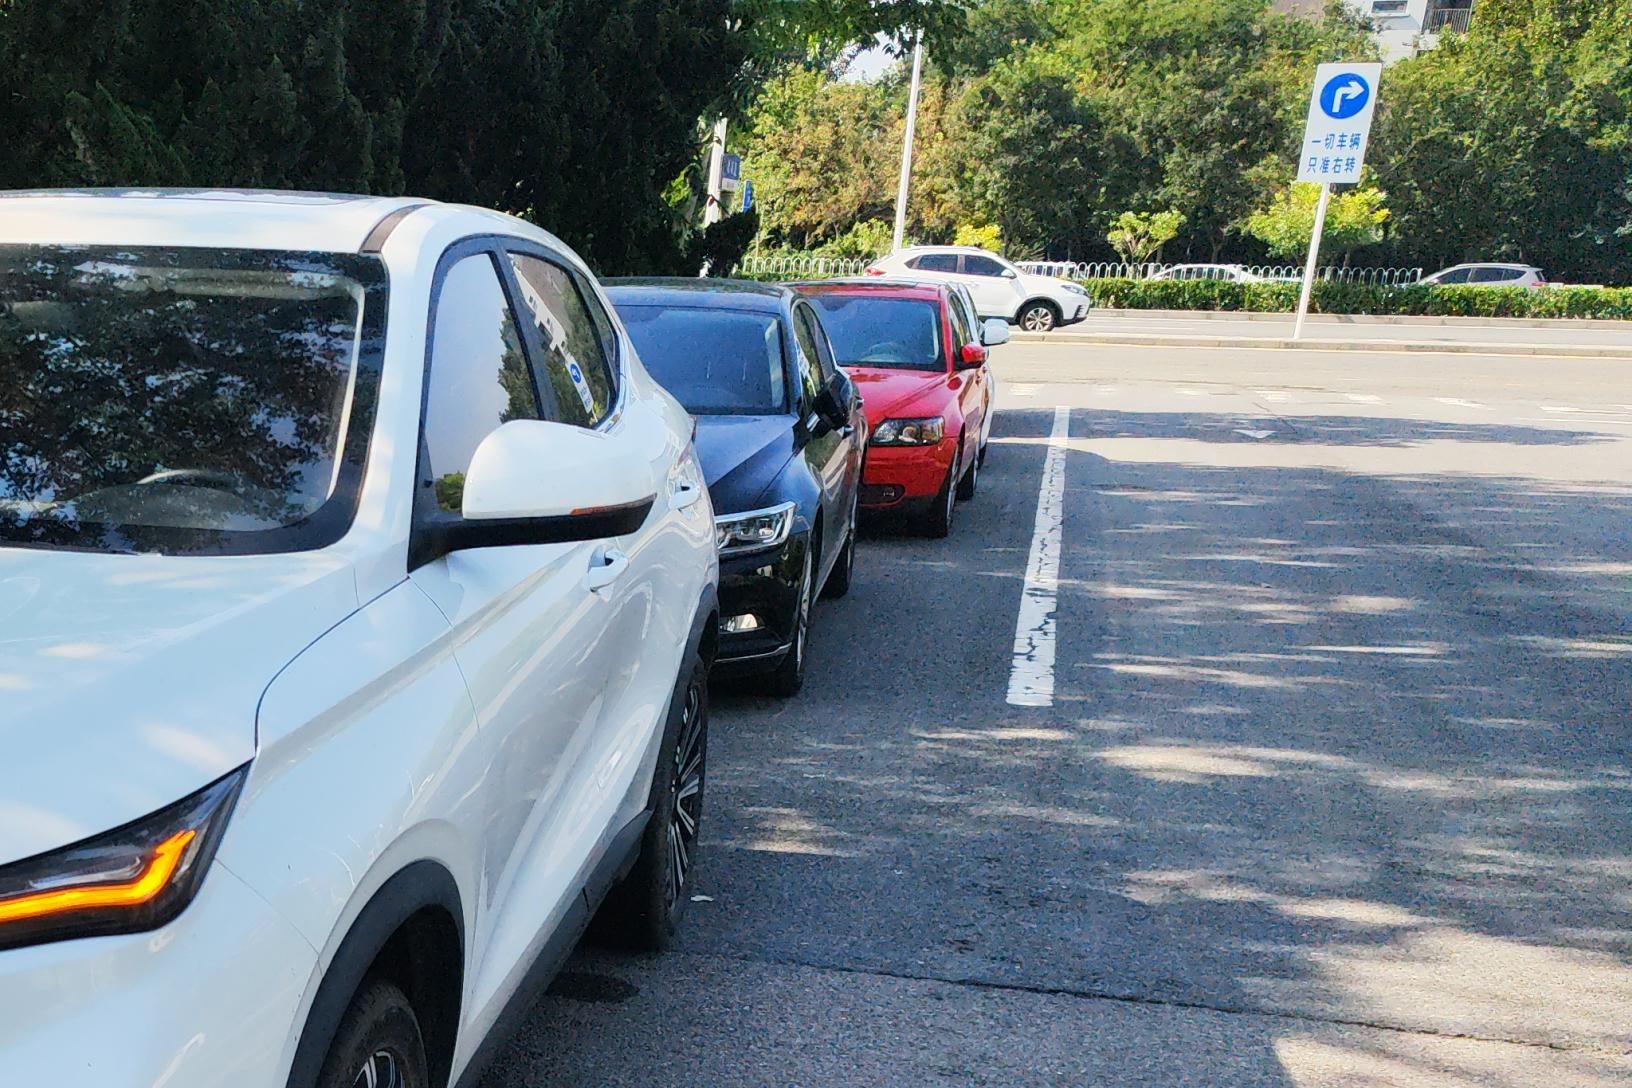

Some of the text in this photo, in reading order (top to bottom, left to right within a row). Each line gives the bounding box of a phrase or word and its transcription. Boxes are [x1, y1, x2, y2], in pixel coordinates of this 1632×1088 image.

[1311, 132, 1362, 151] 一切车辆
[1306, 156, 1356, 174] 只准右转
